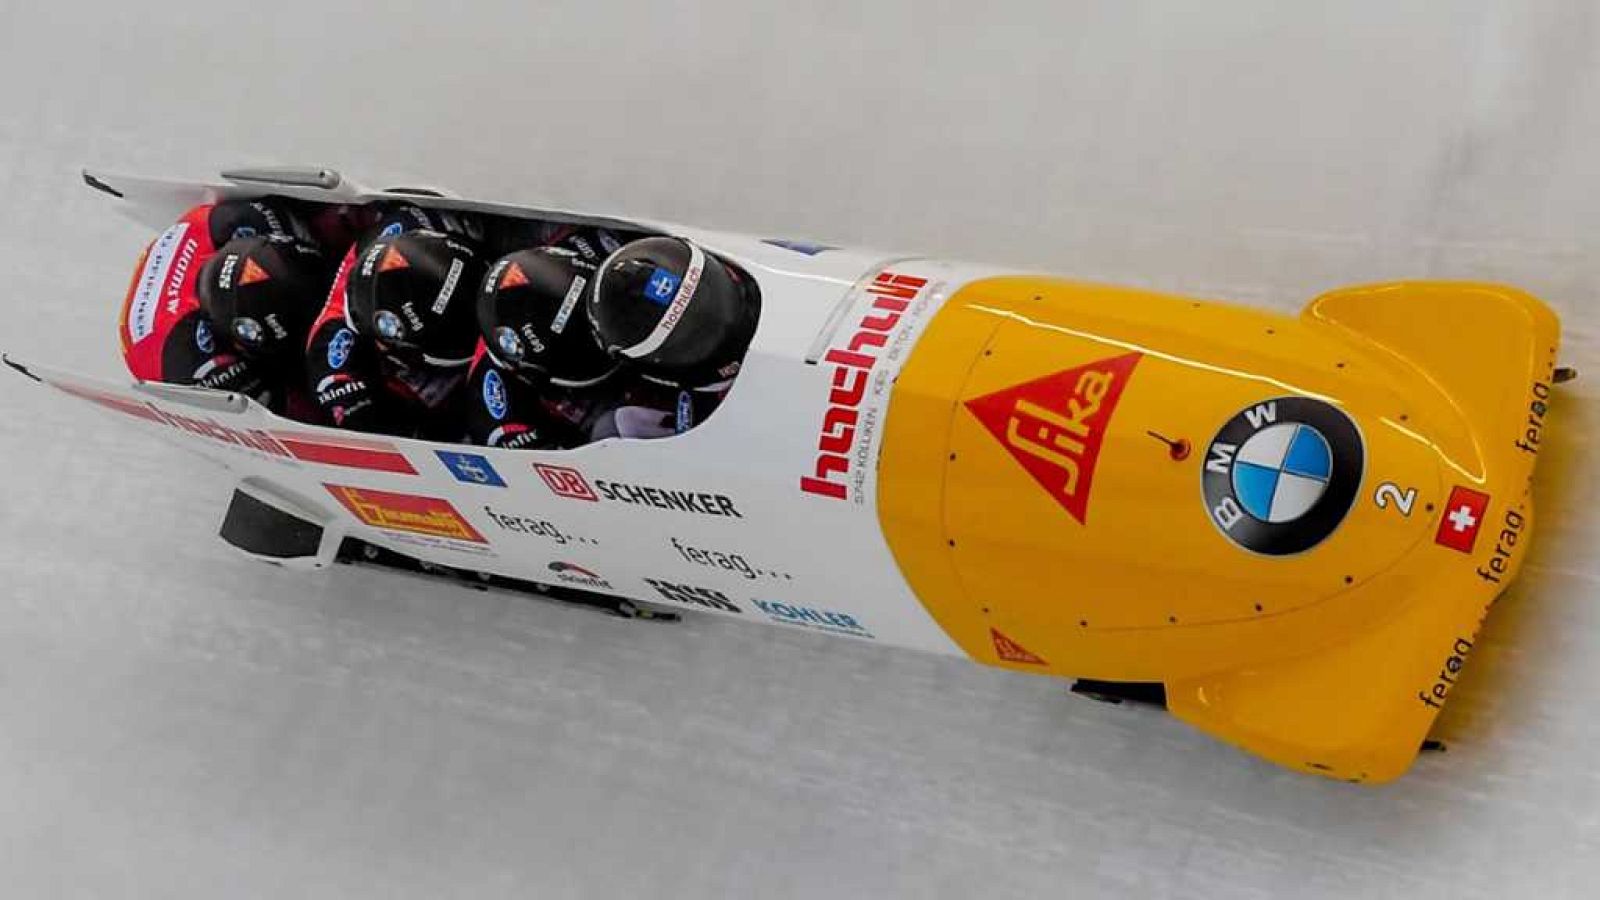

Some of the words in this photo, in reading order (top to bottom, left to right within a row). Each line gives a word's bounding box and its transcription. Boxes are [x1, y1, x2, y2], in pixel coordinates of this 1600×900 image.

[799, 271, 930, 501] hochuli
[1006, 369, 1115, 497] Sika
[547, 467, 588, 494] DB
[595, 480, 742, 519] SCHENKER
[1206, 401, 1279, 531] BMW
[1373, 481, 1418, 516] 2
